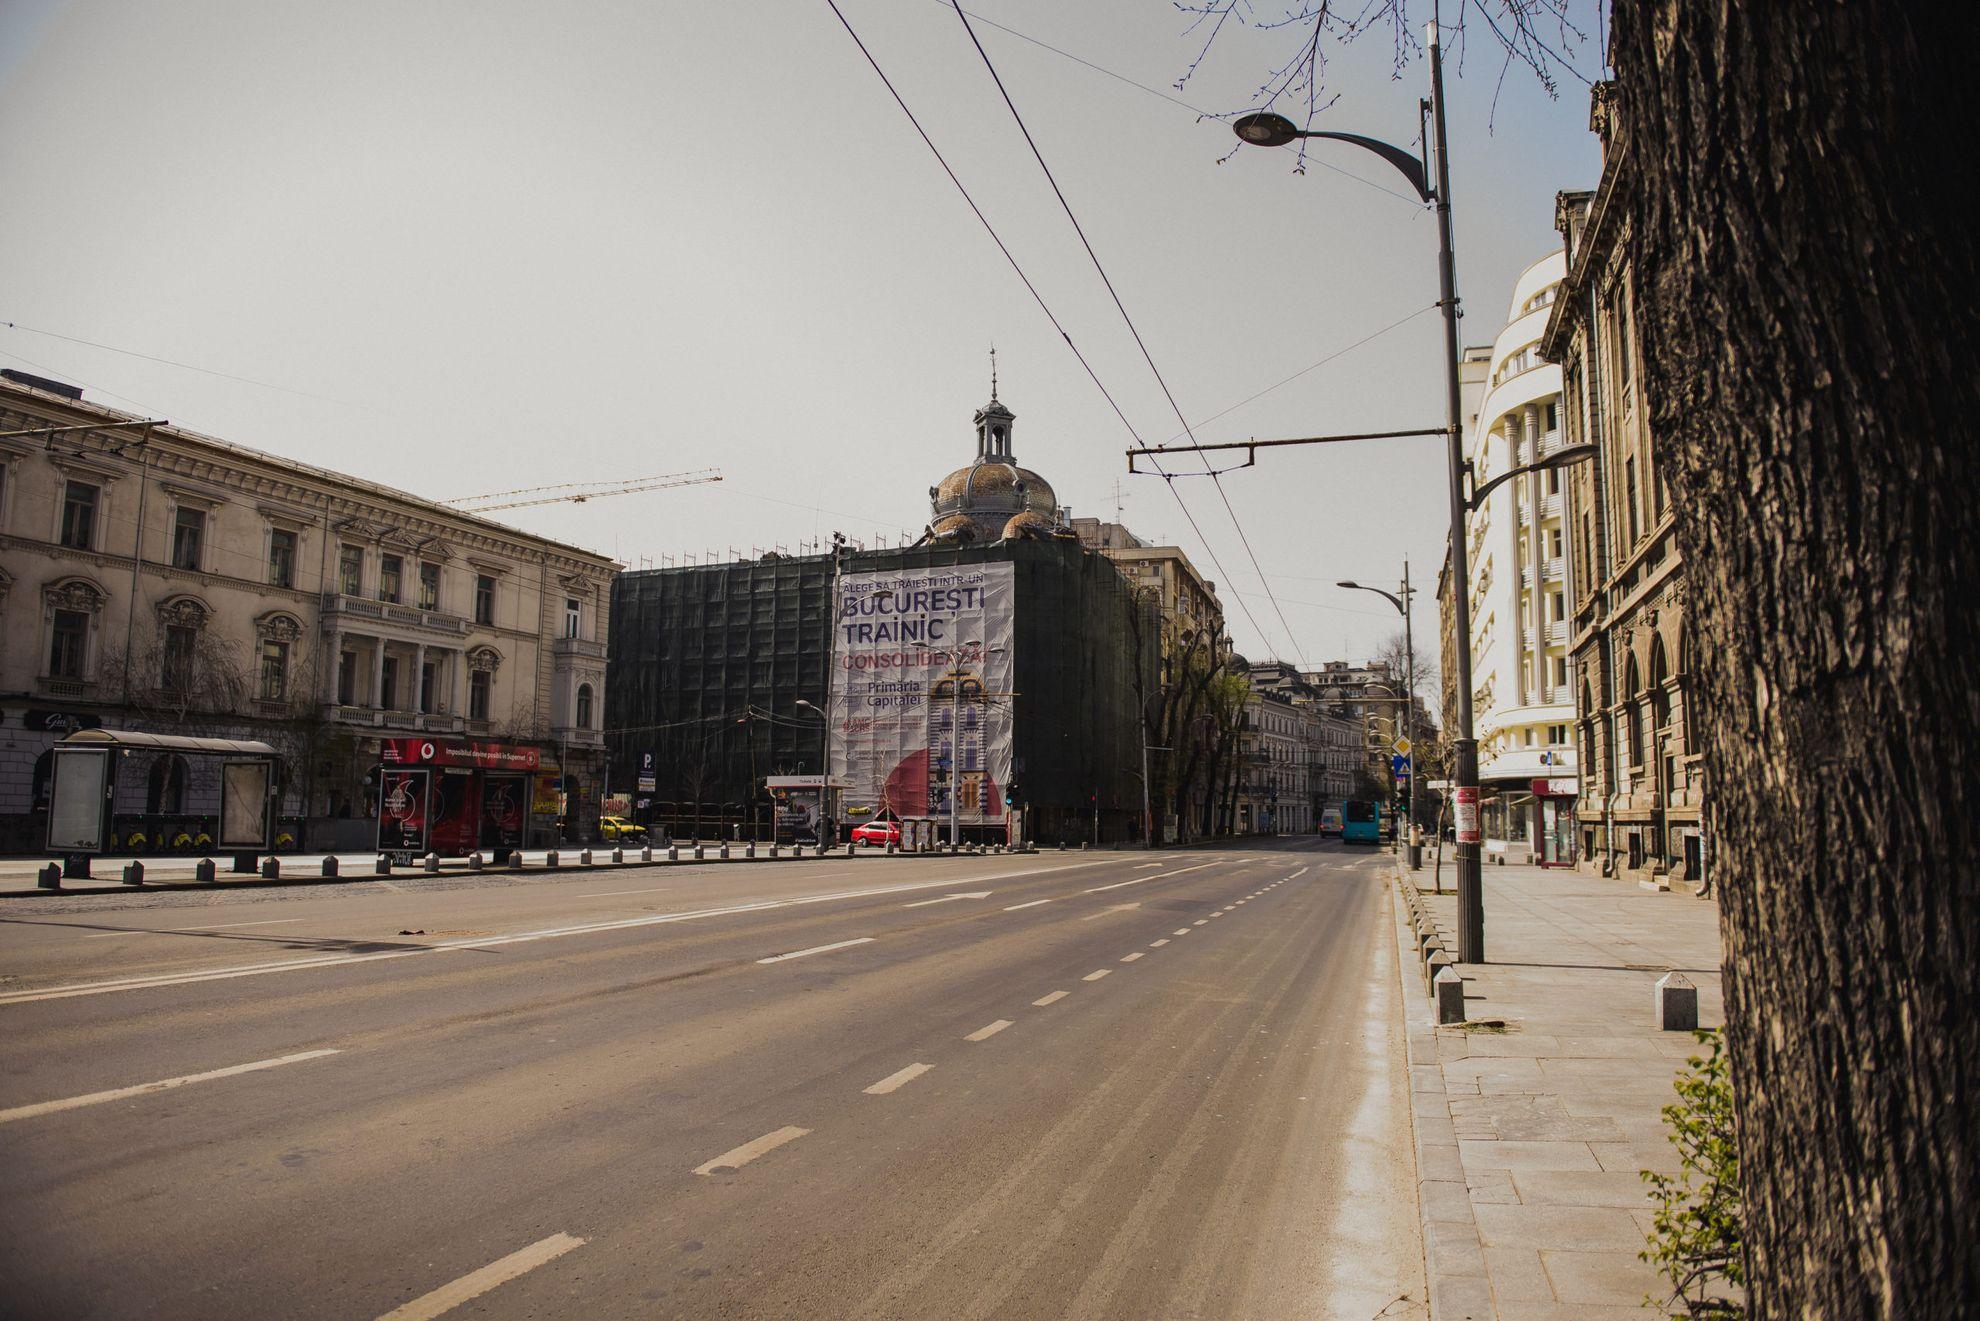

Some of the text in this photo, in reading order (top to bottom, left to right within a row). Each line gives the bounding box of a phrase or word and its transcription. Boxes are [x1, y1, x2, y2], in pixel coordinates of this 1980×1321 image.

[843, 583, 873, 593] ALEGE
[843, 587, 985, 617] BUCUREȘTI
[868, 680, 920, 693] Primăria
[867, 693, 921, 709] Capitalei
